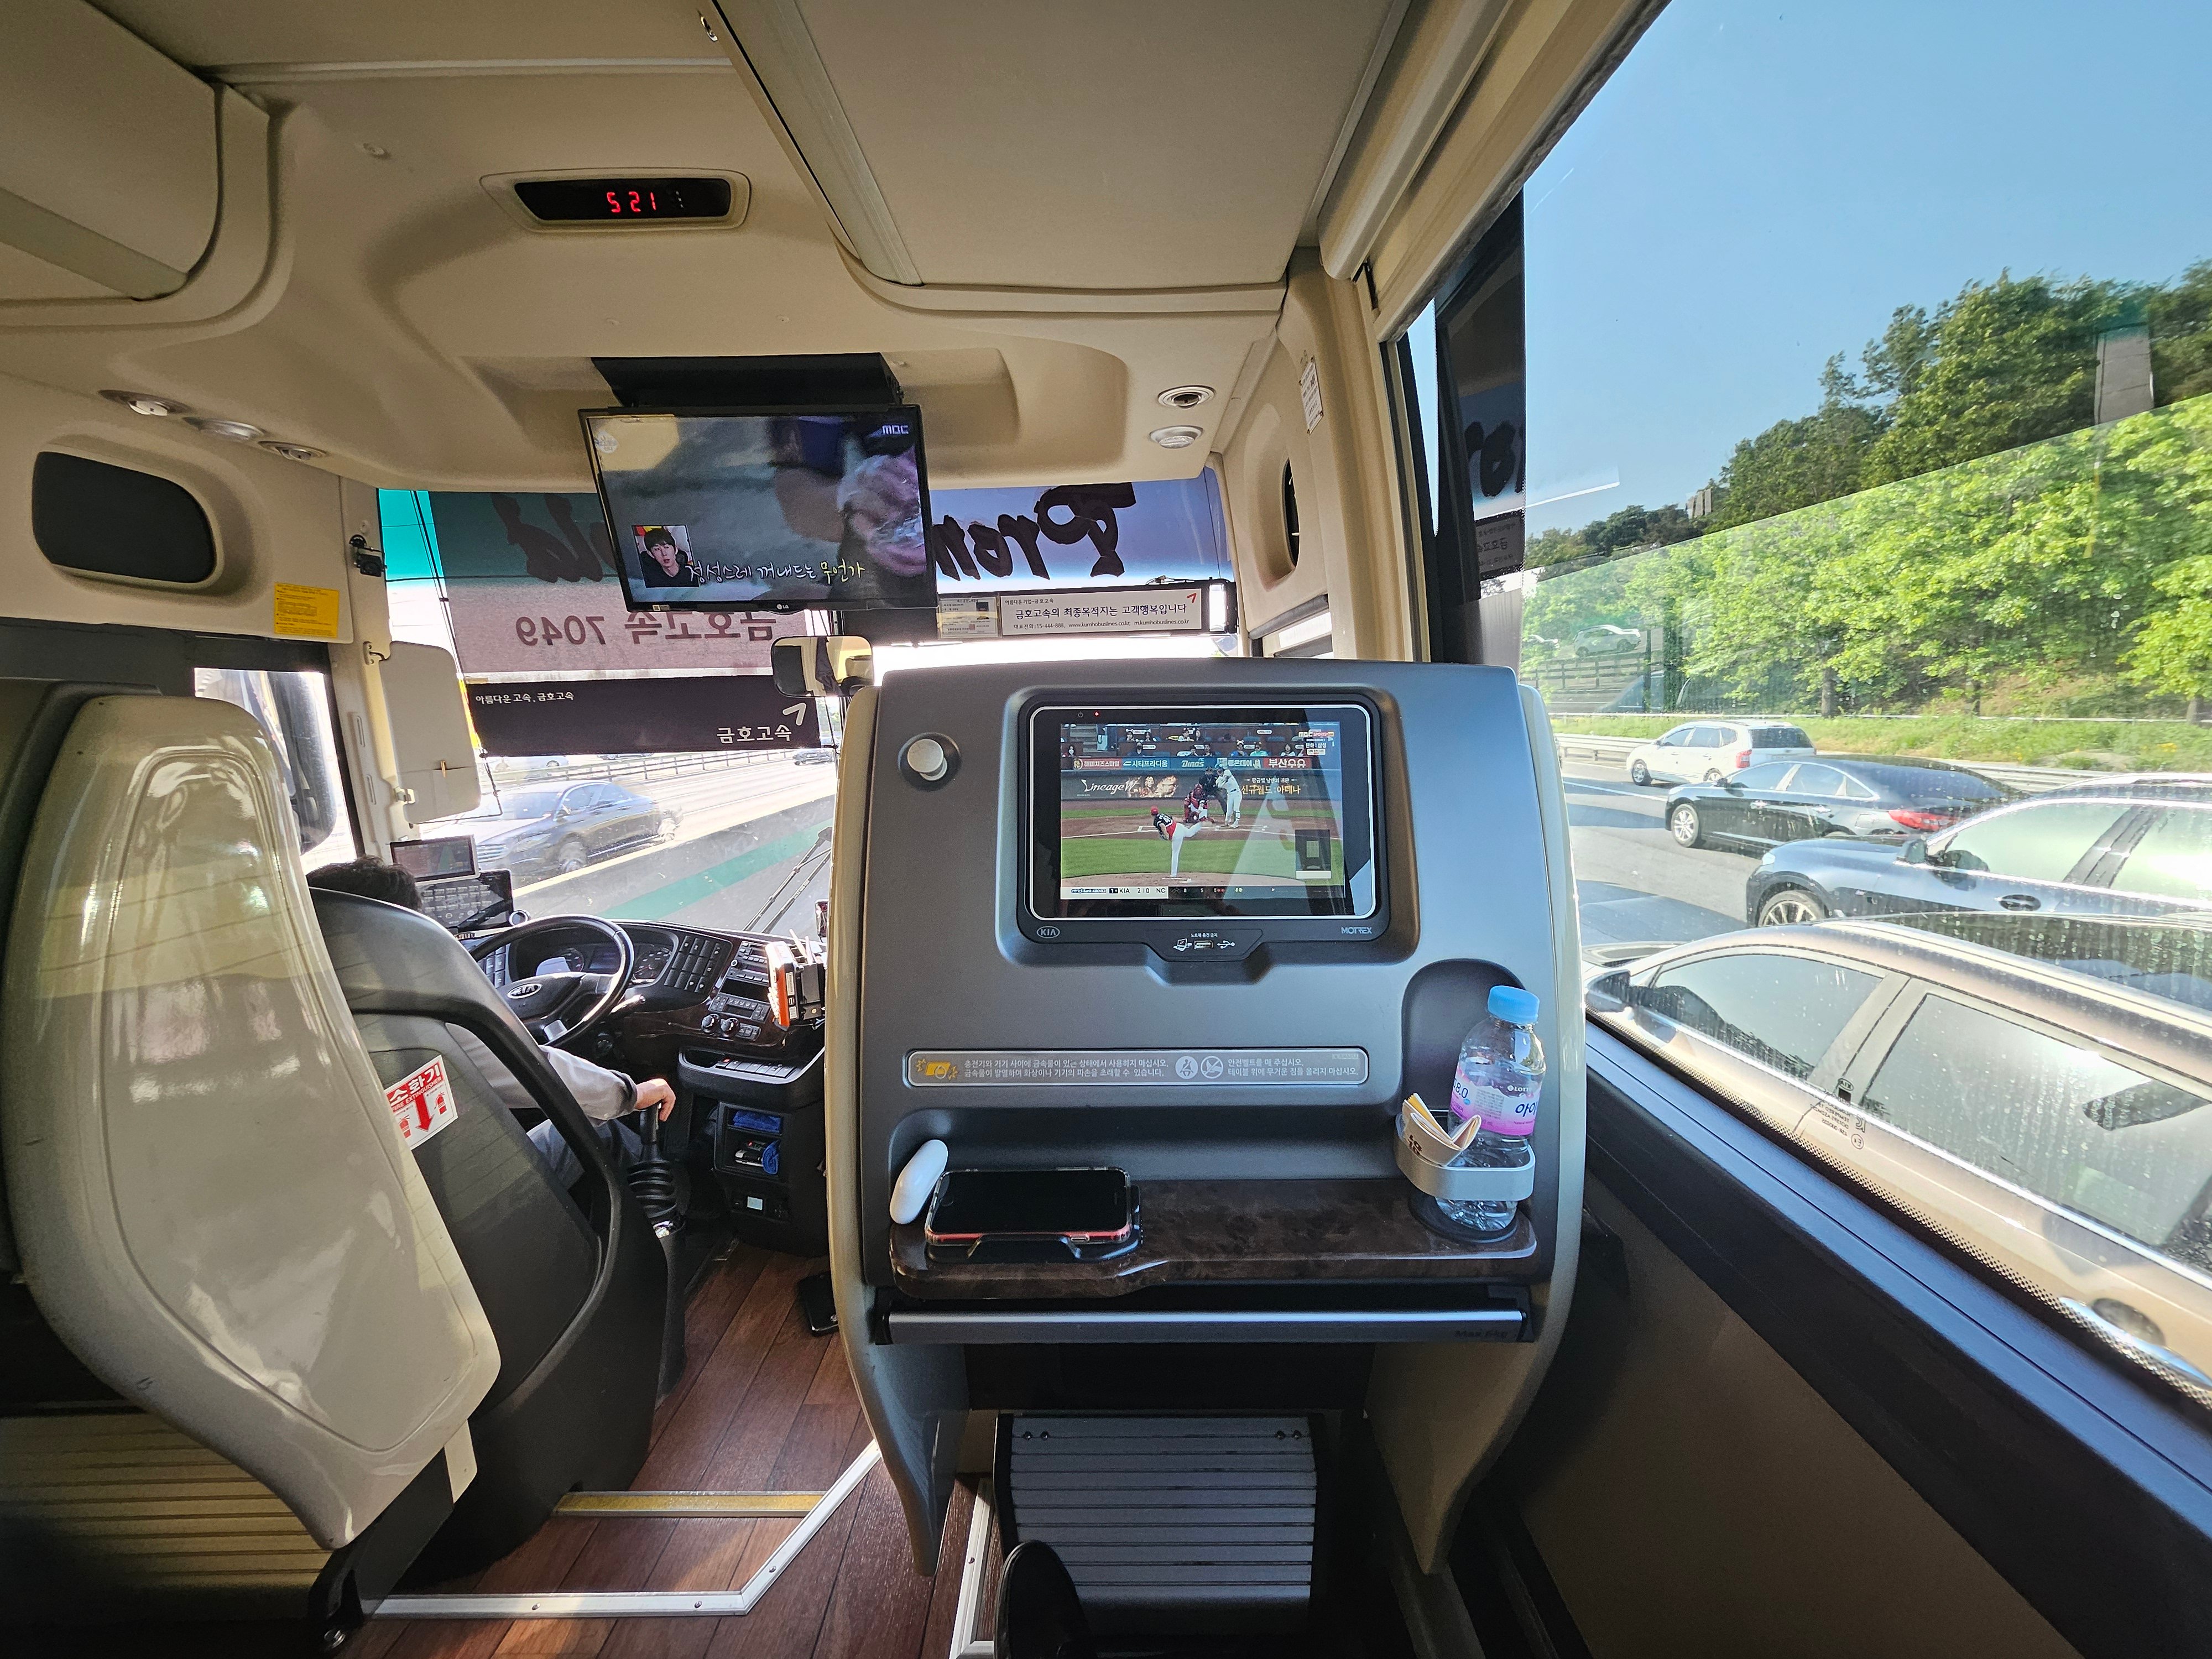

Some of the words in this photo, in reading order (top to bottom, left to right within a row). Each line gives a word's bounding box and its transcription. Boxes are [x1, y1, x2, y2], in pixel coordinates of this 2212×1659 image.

[882, 425, 909, 434] MBC
[685, 561, 751, 583] 정성스레
[757, 562, 816, 579] 꺼내드는
[820, 559, 865, 585] 무언가
[1015, 608, 1060, 619] 금호고속의
[1064, 606, 1118, 618] 최종목적지는
[1122, 603, 1186, 615] 고객행복입니다
[476, 694, 512, 705] 아름다운
[537, 692, 574, 701] 금호고속
[717, 724, 791, 744] 금호고속
[1133, 759, 1168, 768] 시티프라디움
[1269, 759, 1306, 768] 부산우유
[1341, 926, 1373, 935] MOTREX
[512, 984, 535, 995] KIA
[1010, 1060, 1031, 1068] 사이에
[1109, 1059, 1136, 1067] 사용하지
[1228, 1058, 1262, 1067] 안전벨트를
[1274, 1058, 1303, 1067] 주십시오.
[1024, 1069, 1052, 1077] 화상이나
[1251, 1068, 1265, 1076] 위에
[1266, 1068, 1287, 1076] 무거운
[1306, 1067, 1326, 1076] 올리지
[1329, 1067, 1358, 1076] 마십시오.
[389, 1065, 440, 1106] 소화기
[406, 1076, 442, 1103] EXTINGUISHER
